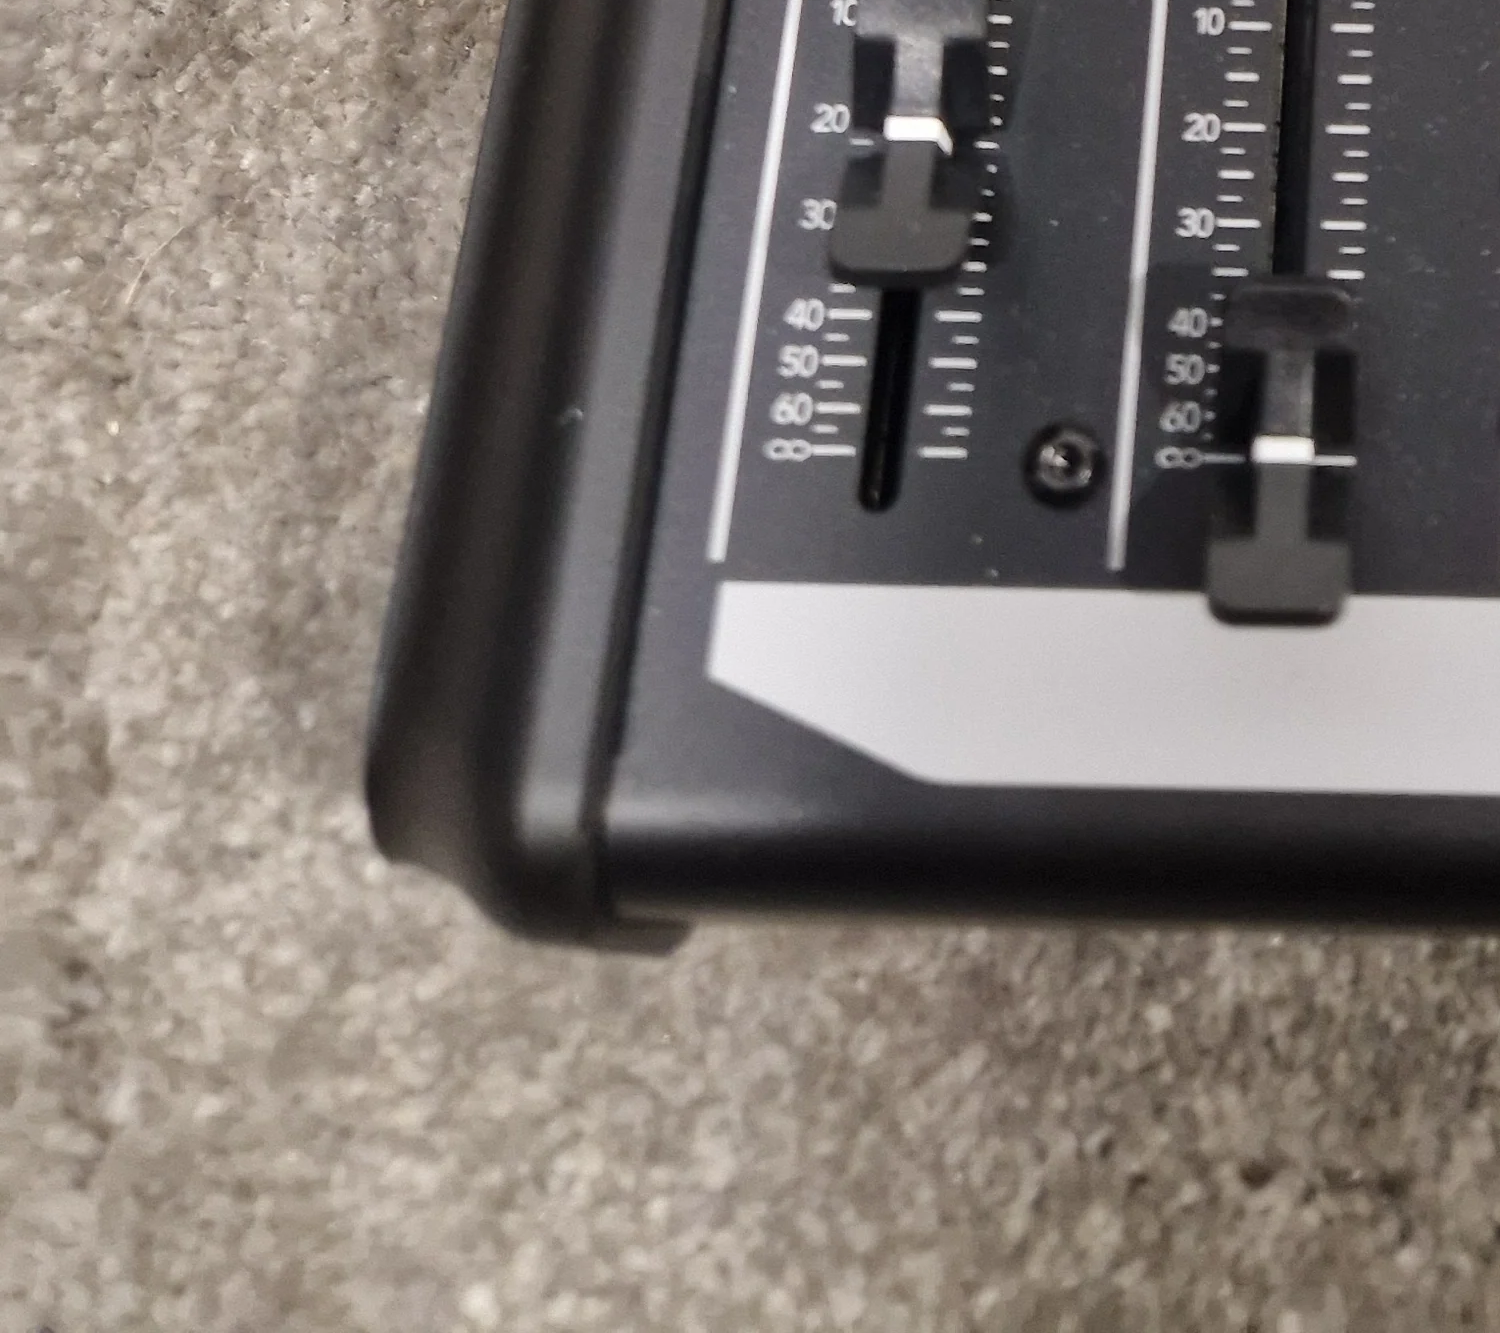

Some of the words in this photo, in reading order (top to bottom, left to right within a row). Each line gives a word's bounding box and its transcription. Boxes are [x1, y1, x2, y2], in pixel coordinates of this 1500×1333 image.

[811, 104, 851, 134] 20
[1182, 113, 1222, 142] 20
[1176, 208, 1215, 238] 30
